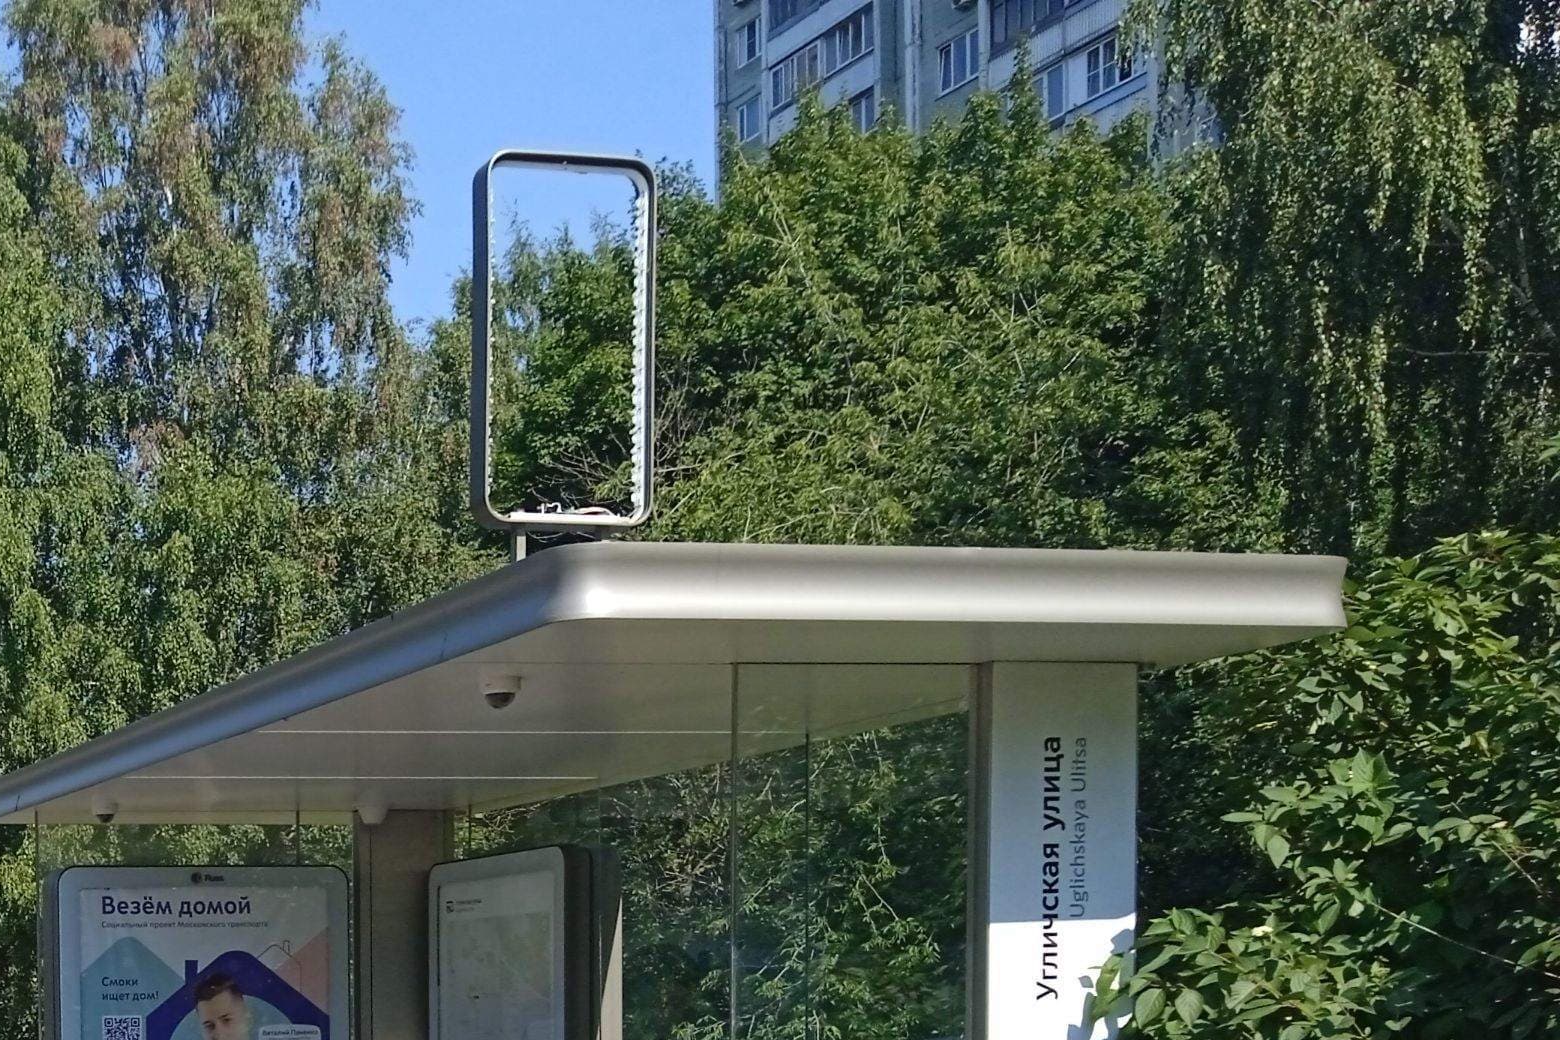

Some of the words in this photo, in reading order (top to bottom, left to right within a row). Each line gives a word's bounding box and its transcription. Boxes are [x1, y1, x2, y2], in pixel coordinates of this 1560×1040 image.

[1043, 736, 1065, 831] улица
[1070, 737, 1087, 792] Ulitsa
[1070, 799, 1089, 918] Uglichskaya
[101, 895, 172, 915] Везём
[178, 895, 252, 918] домой
[150, 920, 176, 930] проект
[1036, 843, 1061, 1000] Угличская
[101, 976, 139, 988] Смоки
[102, 990, 130, 1002] ищет
[132, 990, 159, 1002] дом!
